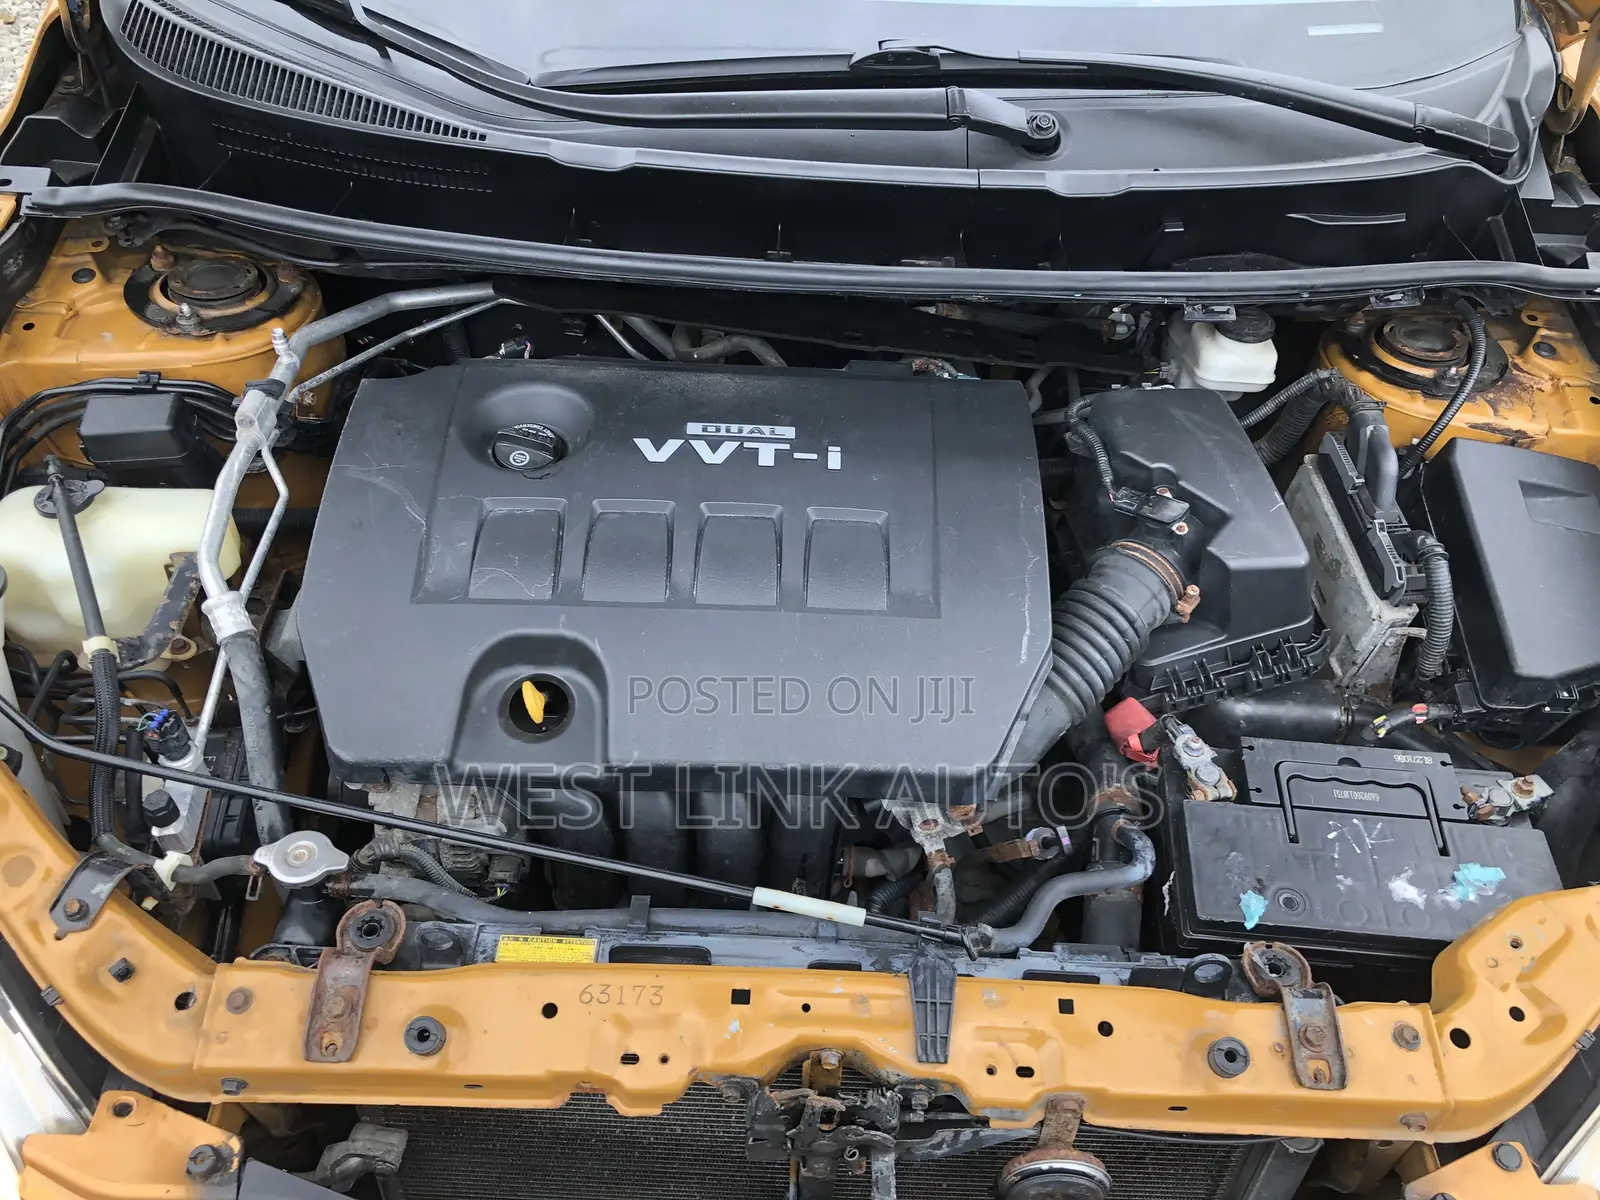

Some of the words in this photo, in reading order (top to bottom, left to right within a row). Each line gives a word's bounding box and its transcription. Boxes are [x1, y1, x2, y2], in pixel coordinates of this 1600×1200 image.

[701, 424, 786, 437] DUAL
[632, 437, 842, 470] VVT-i
[578, 983, 665, 1007] 63173
